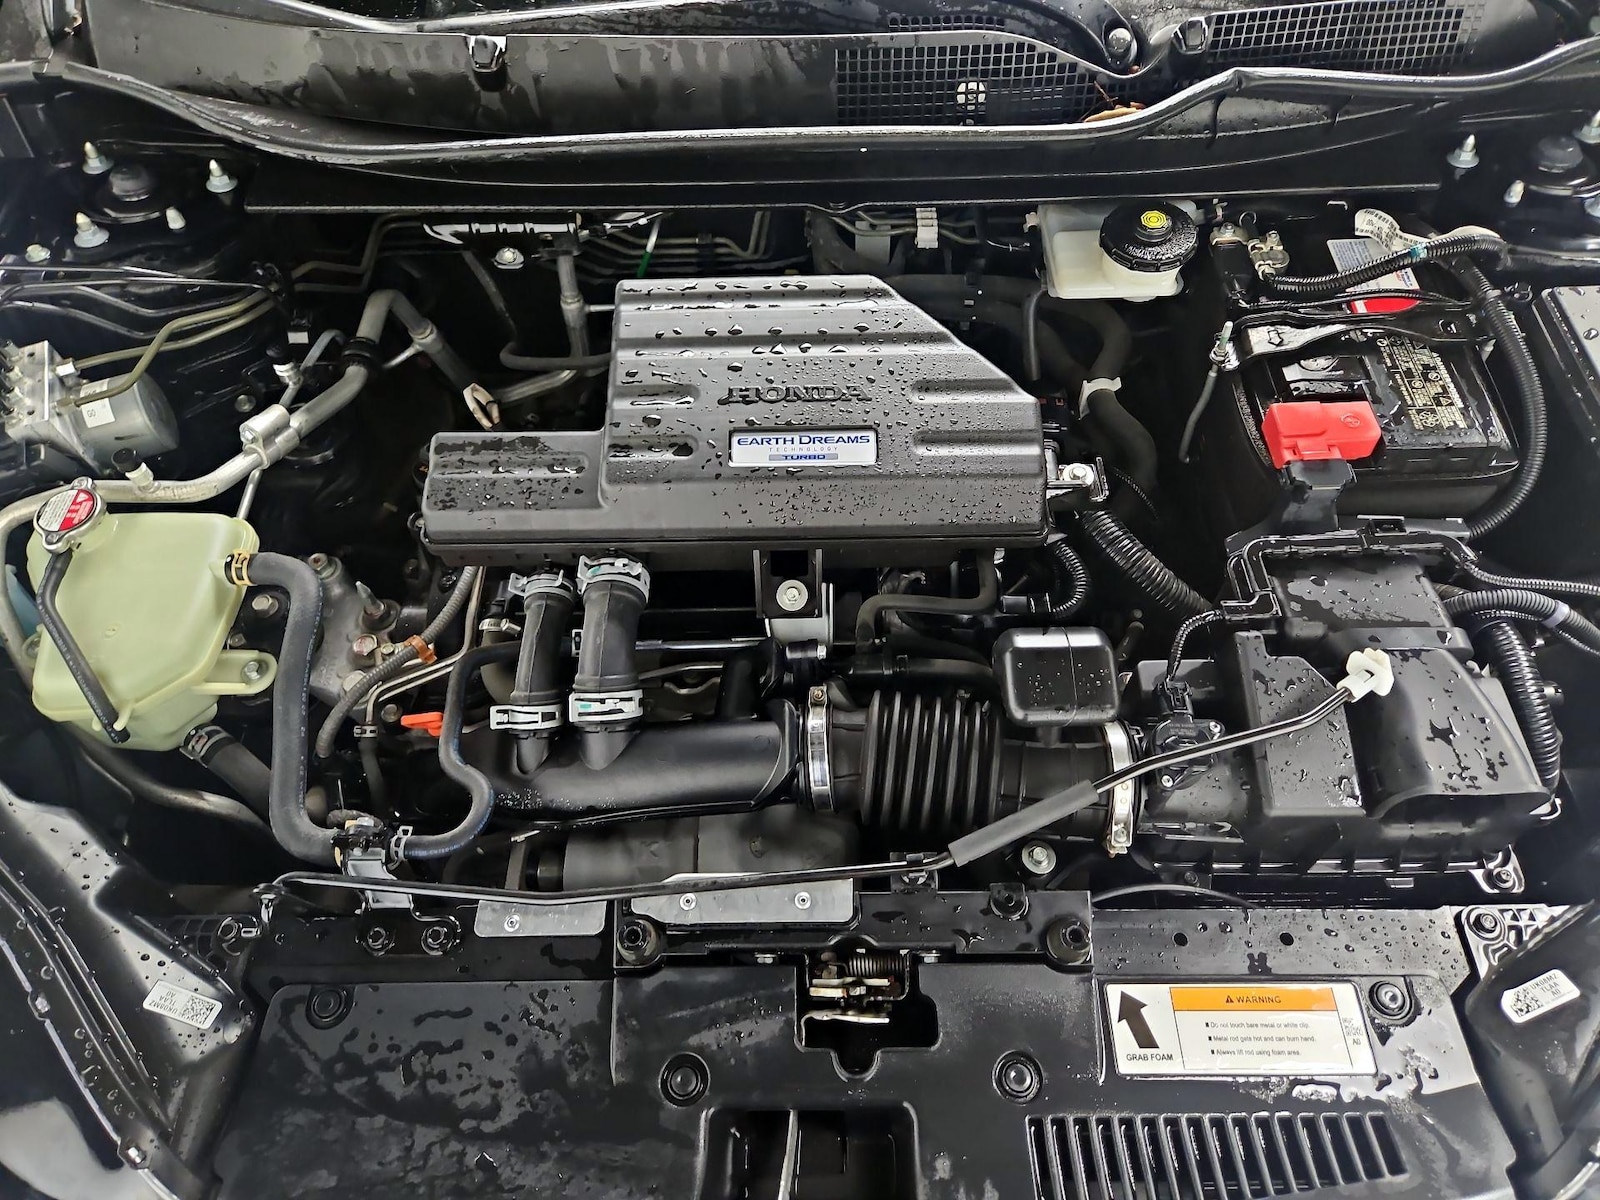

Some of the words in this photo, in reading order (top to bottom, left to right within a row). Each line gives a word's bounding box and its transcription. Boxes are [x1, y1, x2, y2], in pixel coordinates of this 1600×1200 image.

[728, 385, 872, 402] HONDA
[737, 436, 794, 445] EARTH
[798, 435, 870, 444] DREAMS
[1237, 995, 1282, 1004] WARNING
[1126, 1053, 1149, 1061] GRAB
[1151, 1053, 1174, 1061] FOAM
